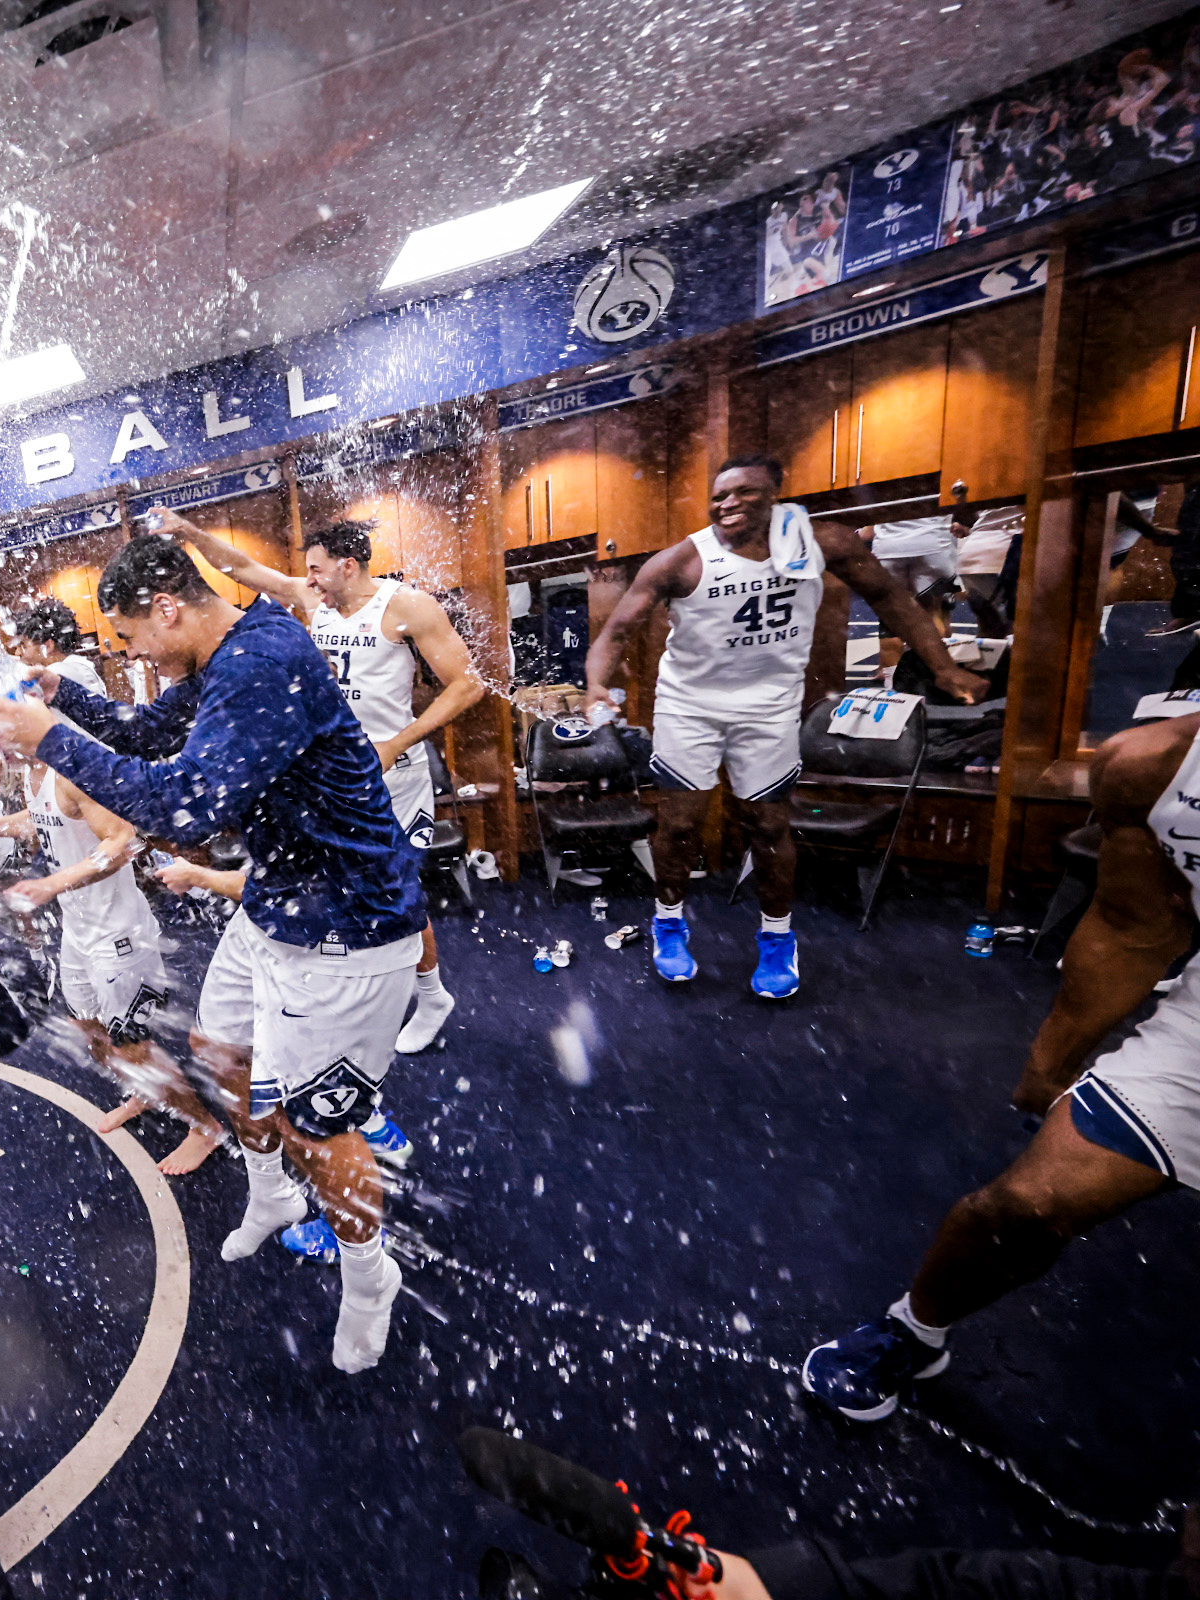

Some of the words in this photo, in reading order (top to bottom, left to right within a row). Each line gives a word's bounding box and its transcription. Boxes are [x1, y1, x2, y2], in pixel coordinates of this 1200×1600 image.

[887, 178, 901, 194] 73
[885, 222, 900, 238] 70
[811, 300, 911, 344] BROWN
[153, 481, 221, 508] STEWART
[707, 576, 807, 599] BRIGHA
[732, 588, 797, 633] 45
[726, 626, 799, 648] YOUNG
